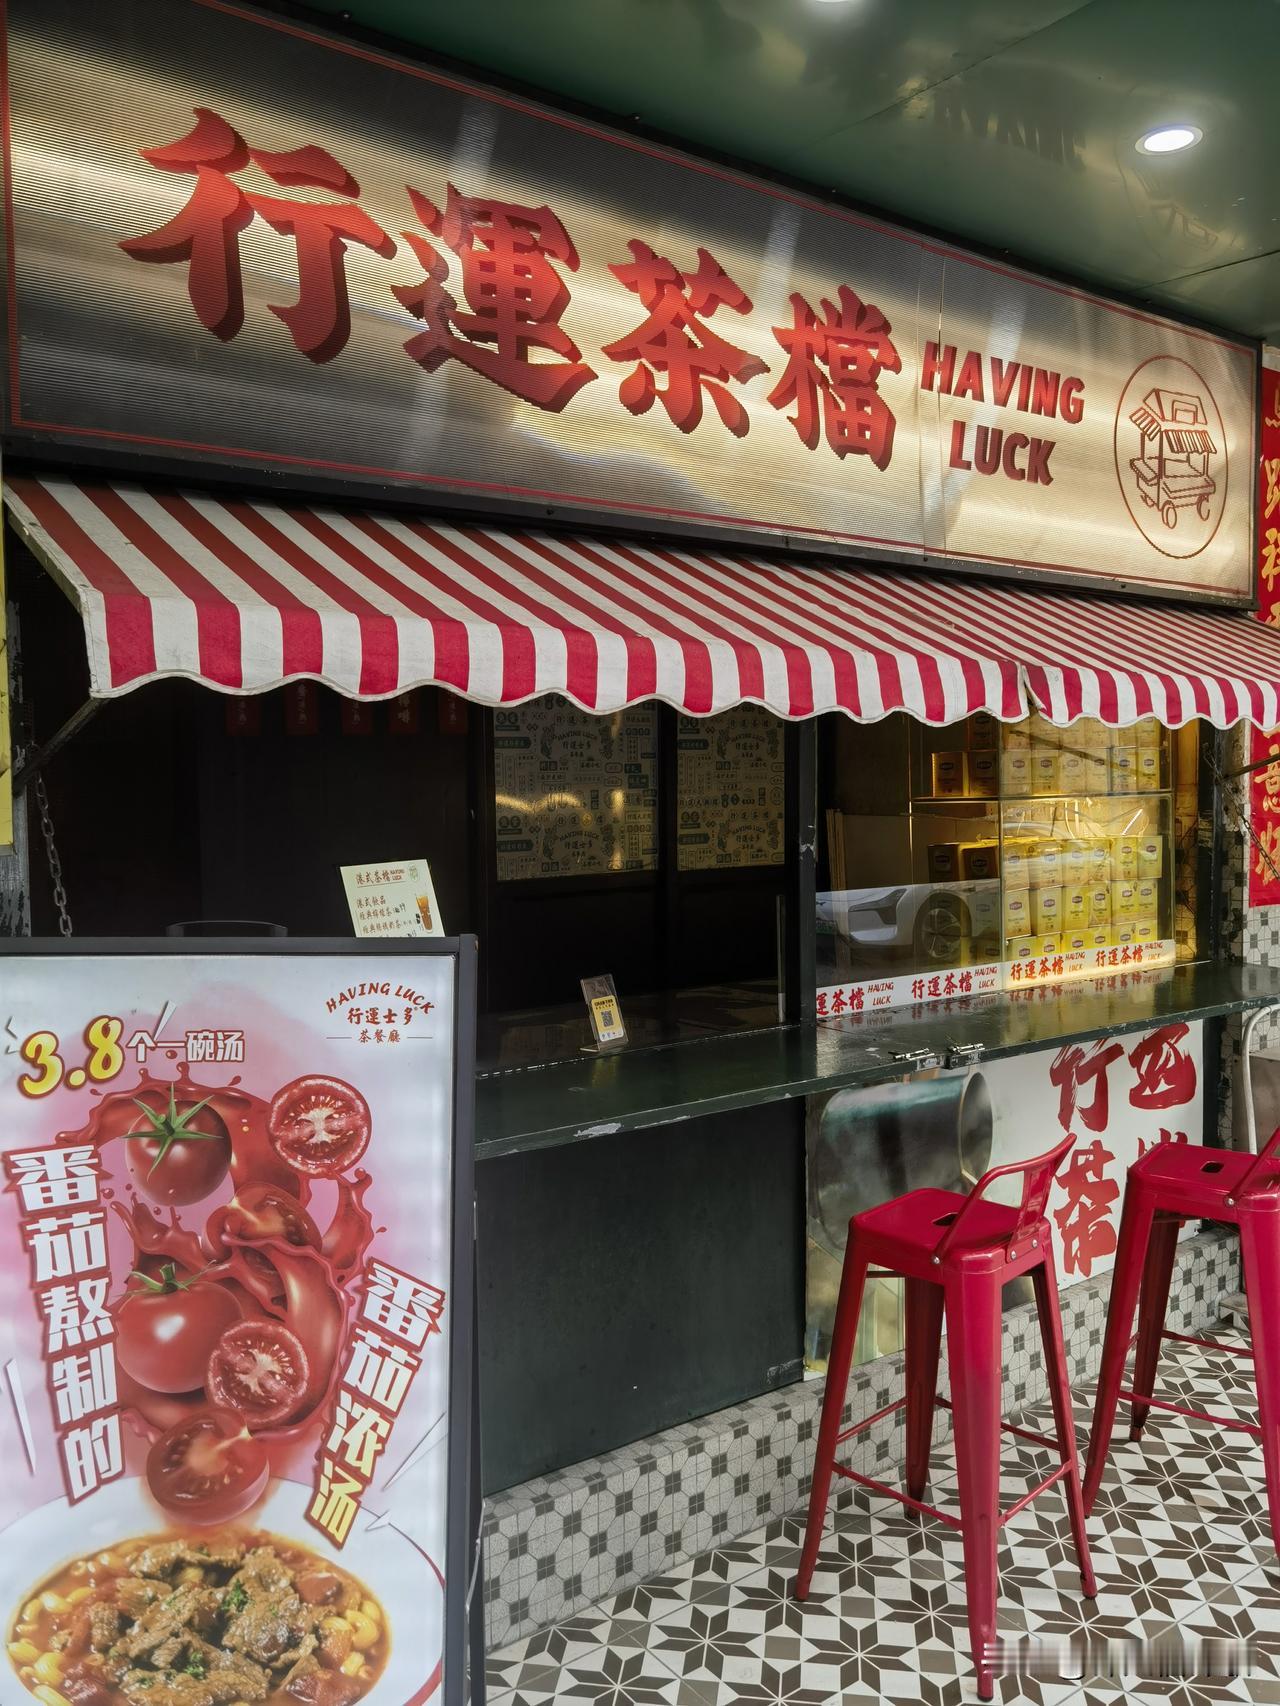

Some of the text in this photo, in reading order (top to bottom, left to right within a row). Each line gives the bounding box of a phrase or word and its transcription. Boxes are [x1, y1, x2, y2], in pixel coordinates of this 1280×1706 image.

[118, 107, 902, 471] 行運茶檔
[920, 340, 1085, 424] HAVING
[949, 420, 1055, 486] LUCK
[974, 966, 998, 977] HAVING
[1010, 955, 1064, 981] 行運茶檔
[326, 982, 435, 1015] HAVING LUCK
[867, 982, 894, 994] HAVING
[912, 971, 973, 1000] 行運茶檔
[978, 979, 995, 989] LUCK
[347, 1007, 413, 1025] 行運士多
[872, 995, 892, 1006] LUCK
[19, 1016, 245, 1097] 3.8 个一碗汤
[6, 1143, 125, 1502] 番茄熬制的
[307, 1260, 444, 1548] 番茄浓汤
